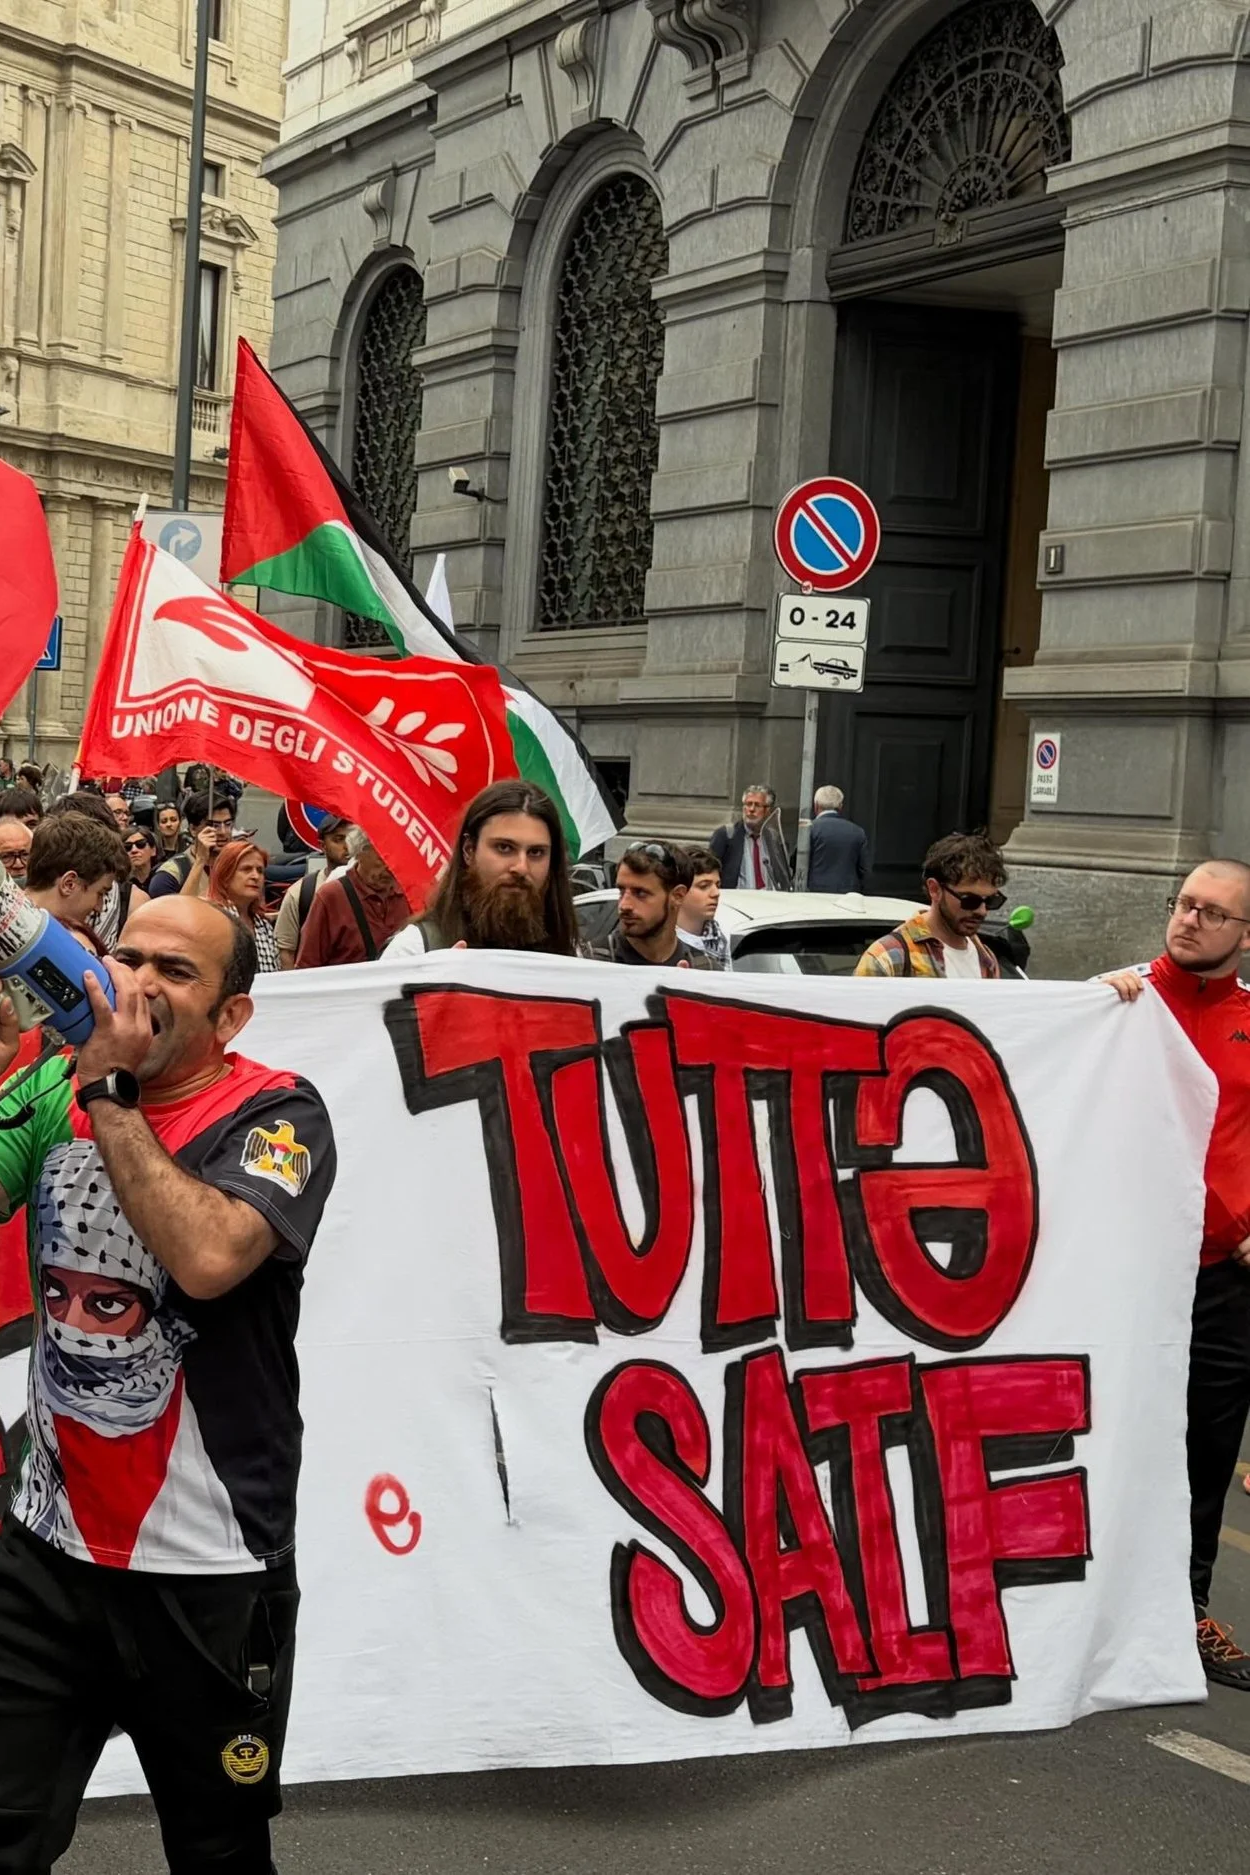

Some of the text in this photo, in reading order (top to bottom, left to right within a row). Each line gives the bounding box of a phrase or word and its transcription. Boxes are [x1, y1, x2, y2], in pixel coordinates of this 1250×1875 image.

[825, 609, 856, 629] 24
[111, 697, 450, 882] UNIONE DEGLI STUDENT
[364, 1472, 423, 1556] e
[584, 1344, 1093, 1732] SAIF
